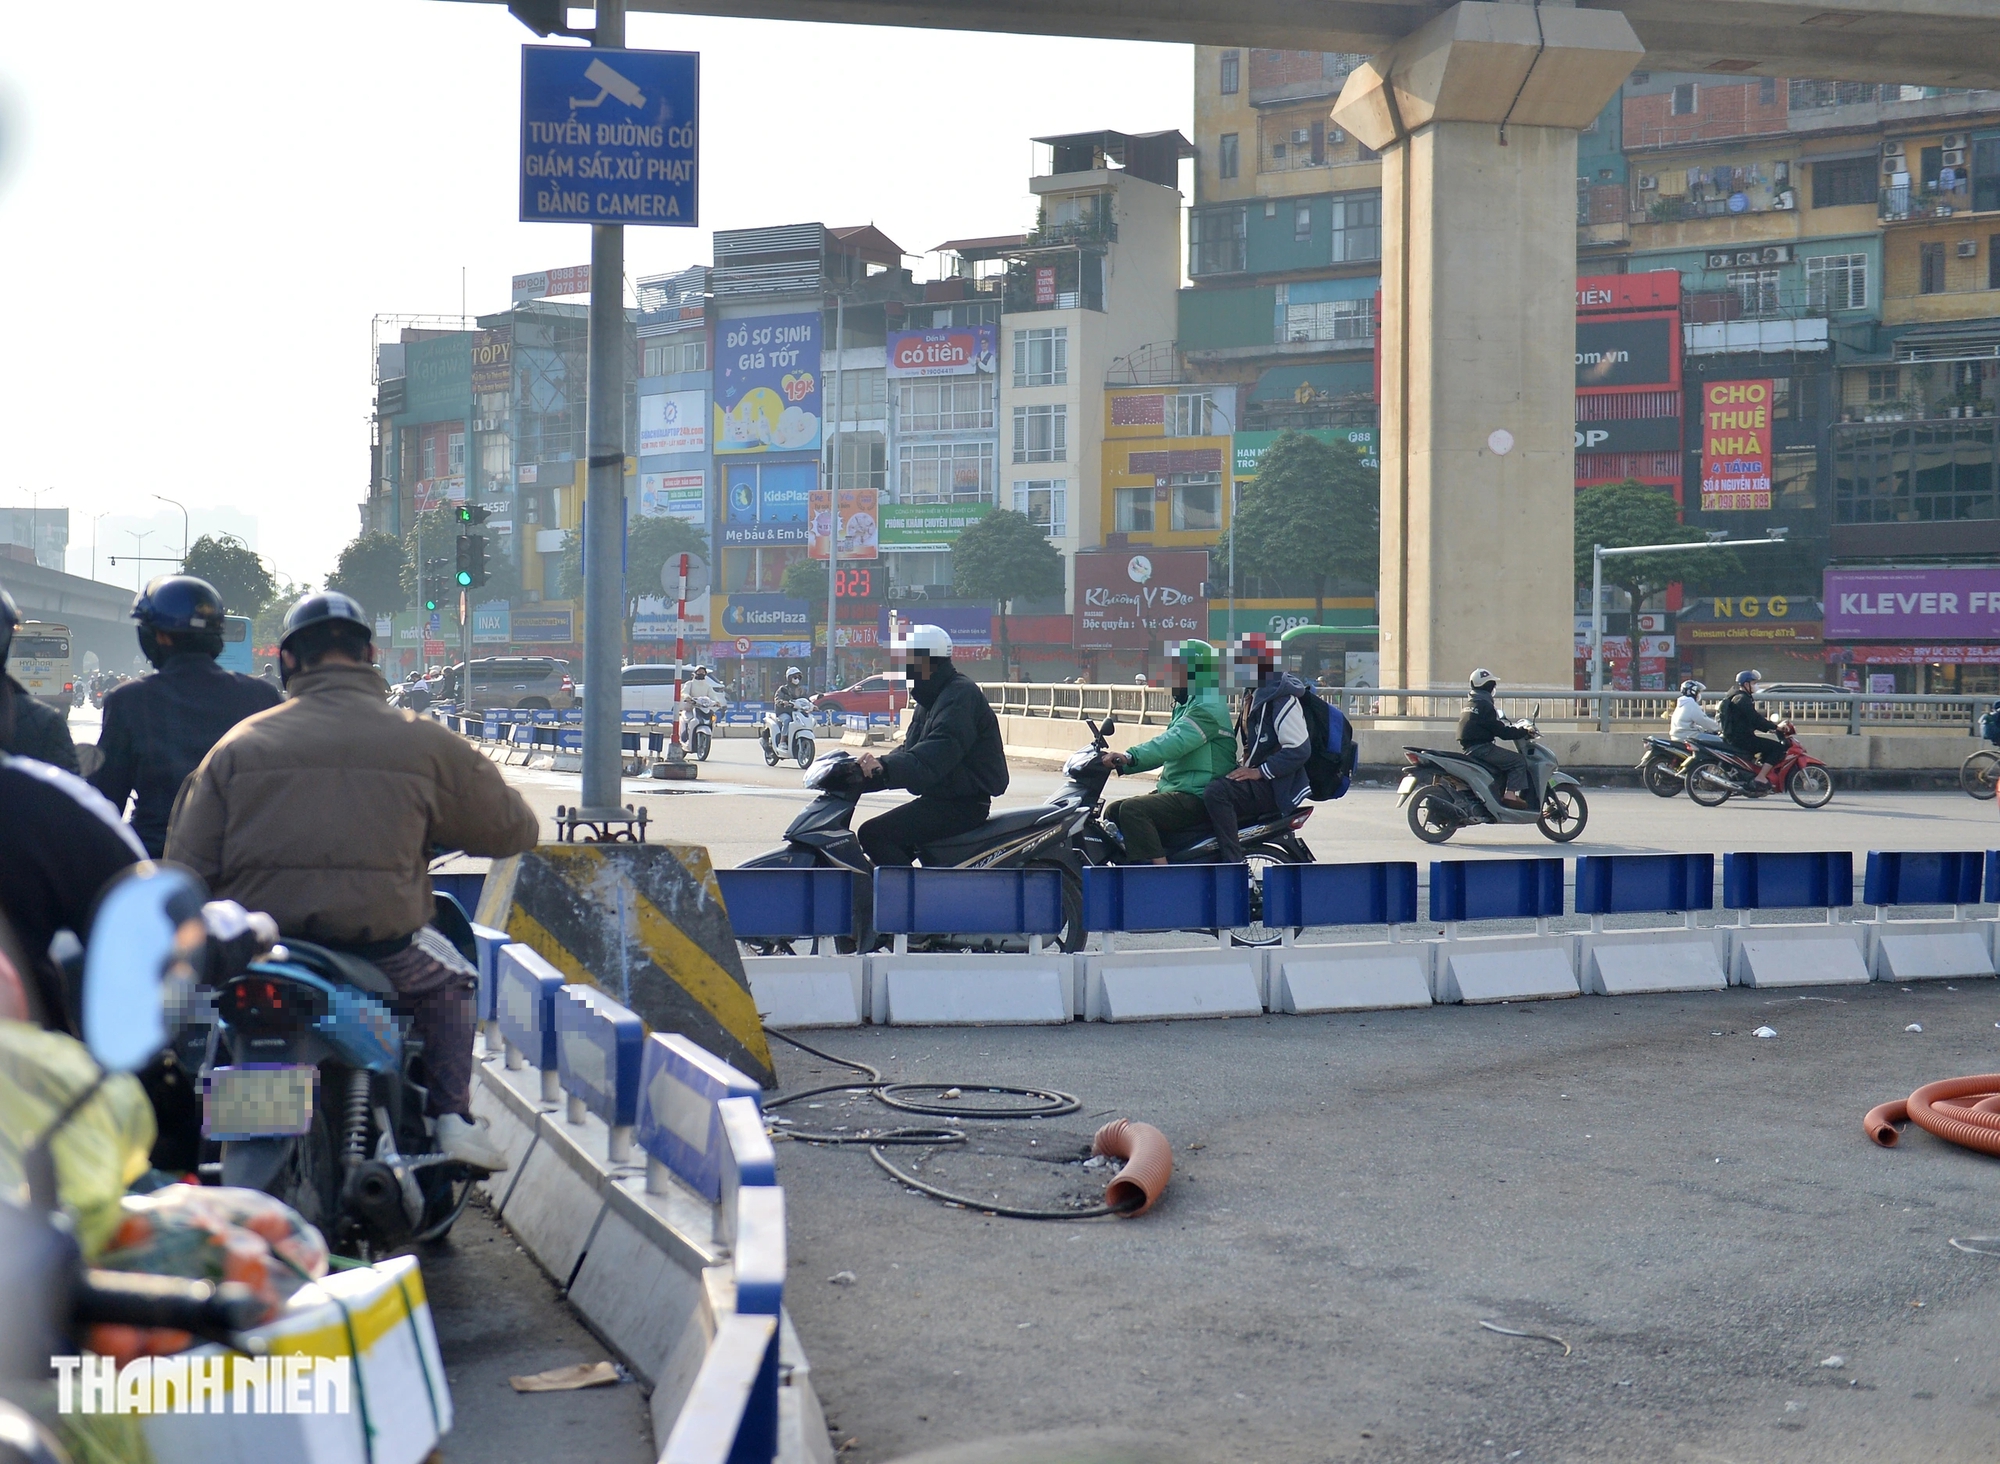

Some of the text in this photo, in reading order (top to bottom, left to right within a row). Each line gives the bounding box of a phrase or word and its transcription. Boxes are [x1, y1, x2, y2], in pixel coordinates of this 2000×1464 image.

[529, 112, 693, 149] TUYẾN ĐƯỜNG CÓ
[525, 149, 574, 178] GIÁM
[647, 159, 693, 187] PHẠT
[537, 180, 680, 217] BẰNG CAMERA
[551, 267, 574, 280] 0988
[551, 281, 574, 294] 0978
[727, 323, 811, 348] ĐỒ SƠ SINH
[471, 343, 510, 365] TOPY
[769, 344, 799, 368] TỐT
[901, 342, 963, 364] có tiền
[1575, 350, 1629, 365] om.vn
[1710, 384, 1766, 405] CHO
[1709, 405, 1766, 430] THUÊ
[1710, 431, 1762, 456] NHÀ
[1237, 460, 1258, 468] TRO
[1712, 458, 1762, 473] 4 TẦNG
[764, 491, 808, 502] KidsPlaz
[949, 517, 965, 528] KHOA
[726, 530, 743, 543] Mẹ
[745, 525, 765, 540] bầu
[767, 529, 775, 539] &
[777, 529, 794, 539] Em
[1840, 593, 1959, 614] KLEVER
[479, 616, 500, 629] INAX
[747, 611, 806, 624] KidsPlaza
[1083, 618, 1100, 630] Độc
[1180, 618, 1197, 631] Gáy
[825, 838, 849, 850] HONDA
